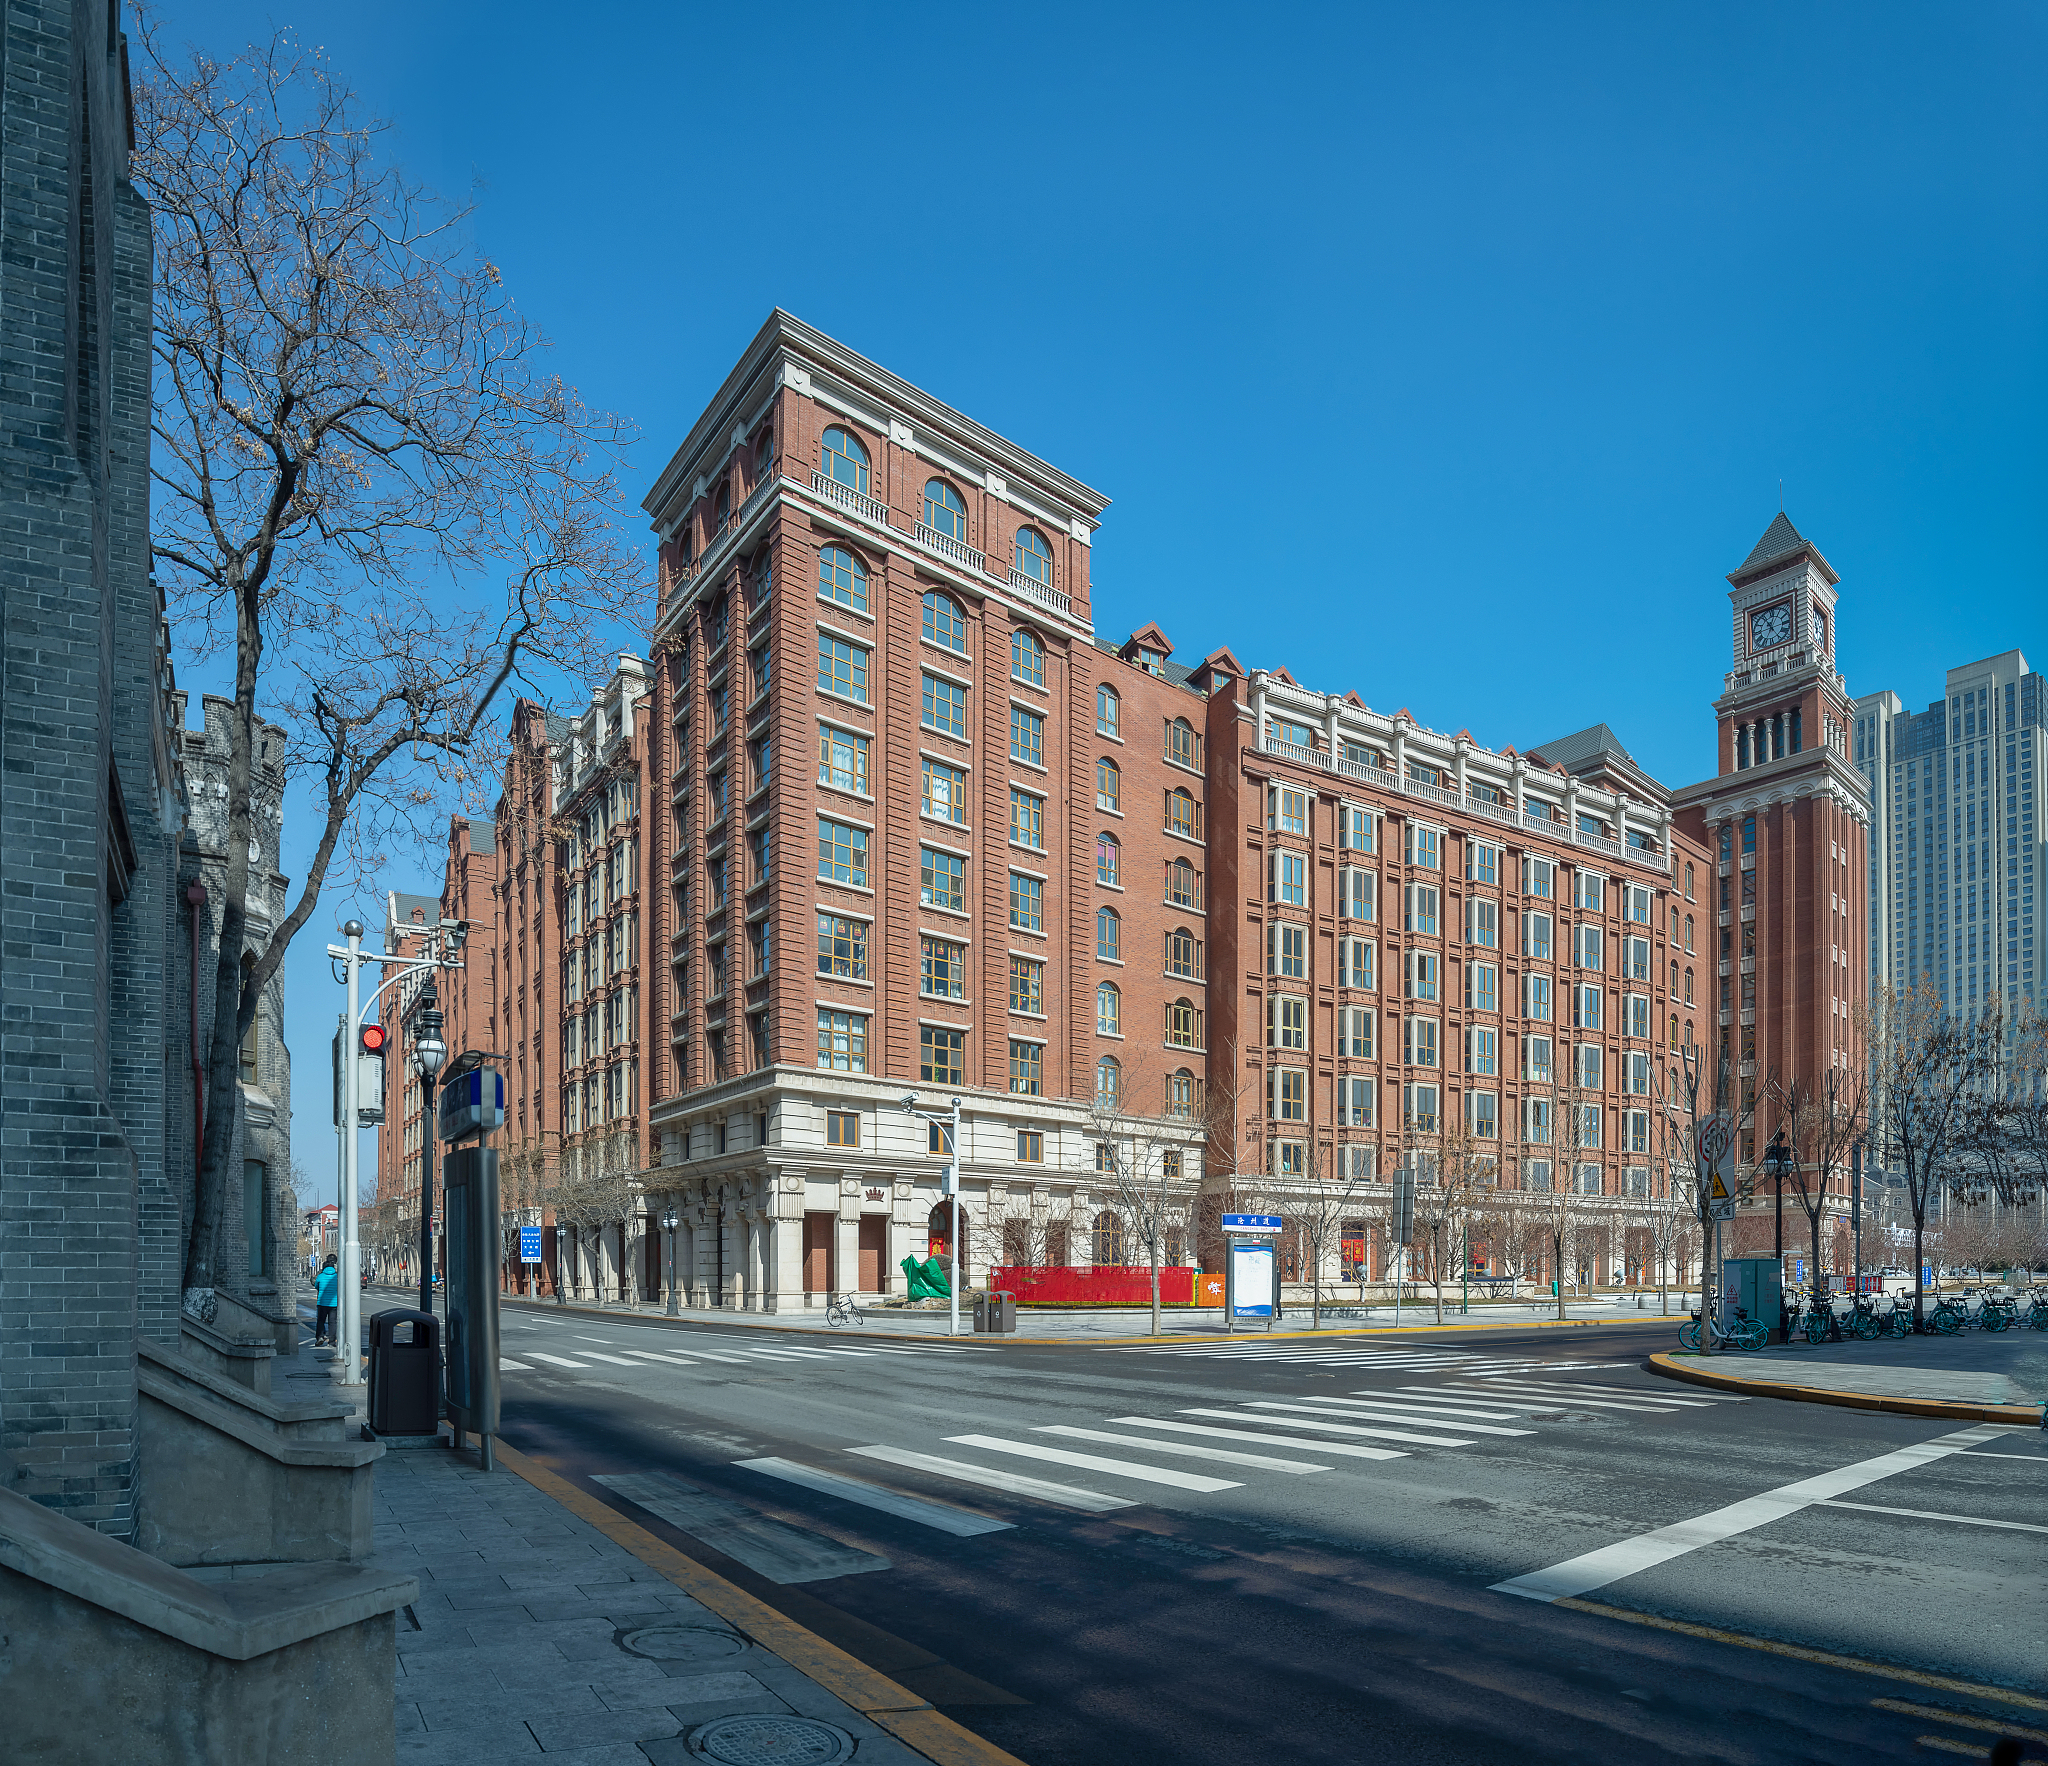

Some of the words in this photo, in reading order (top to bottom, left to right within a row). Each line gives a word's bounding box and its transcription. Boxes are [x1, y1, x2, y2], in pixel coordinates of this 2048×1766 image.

[1704, 1127, 1724, 1154] 30
[1237, 1216, 1270, 1226] 沧州道
